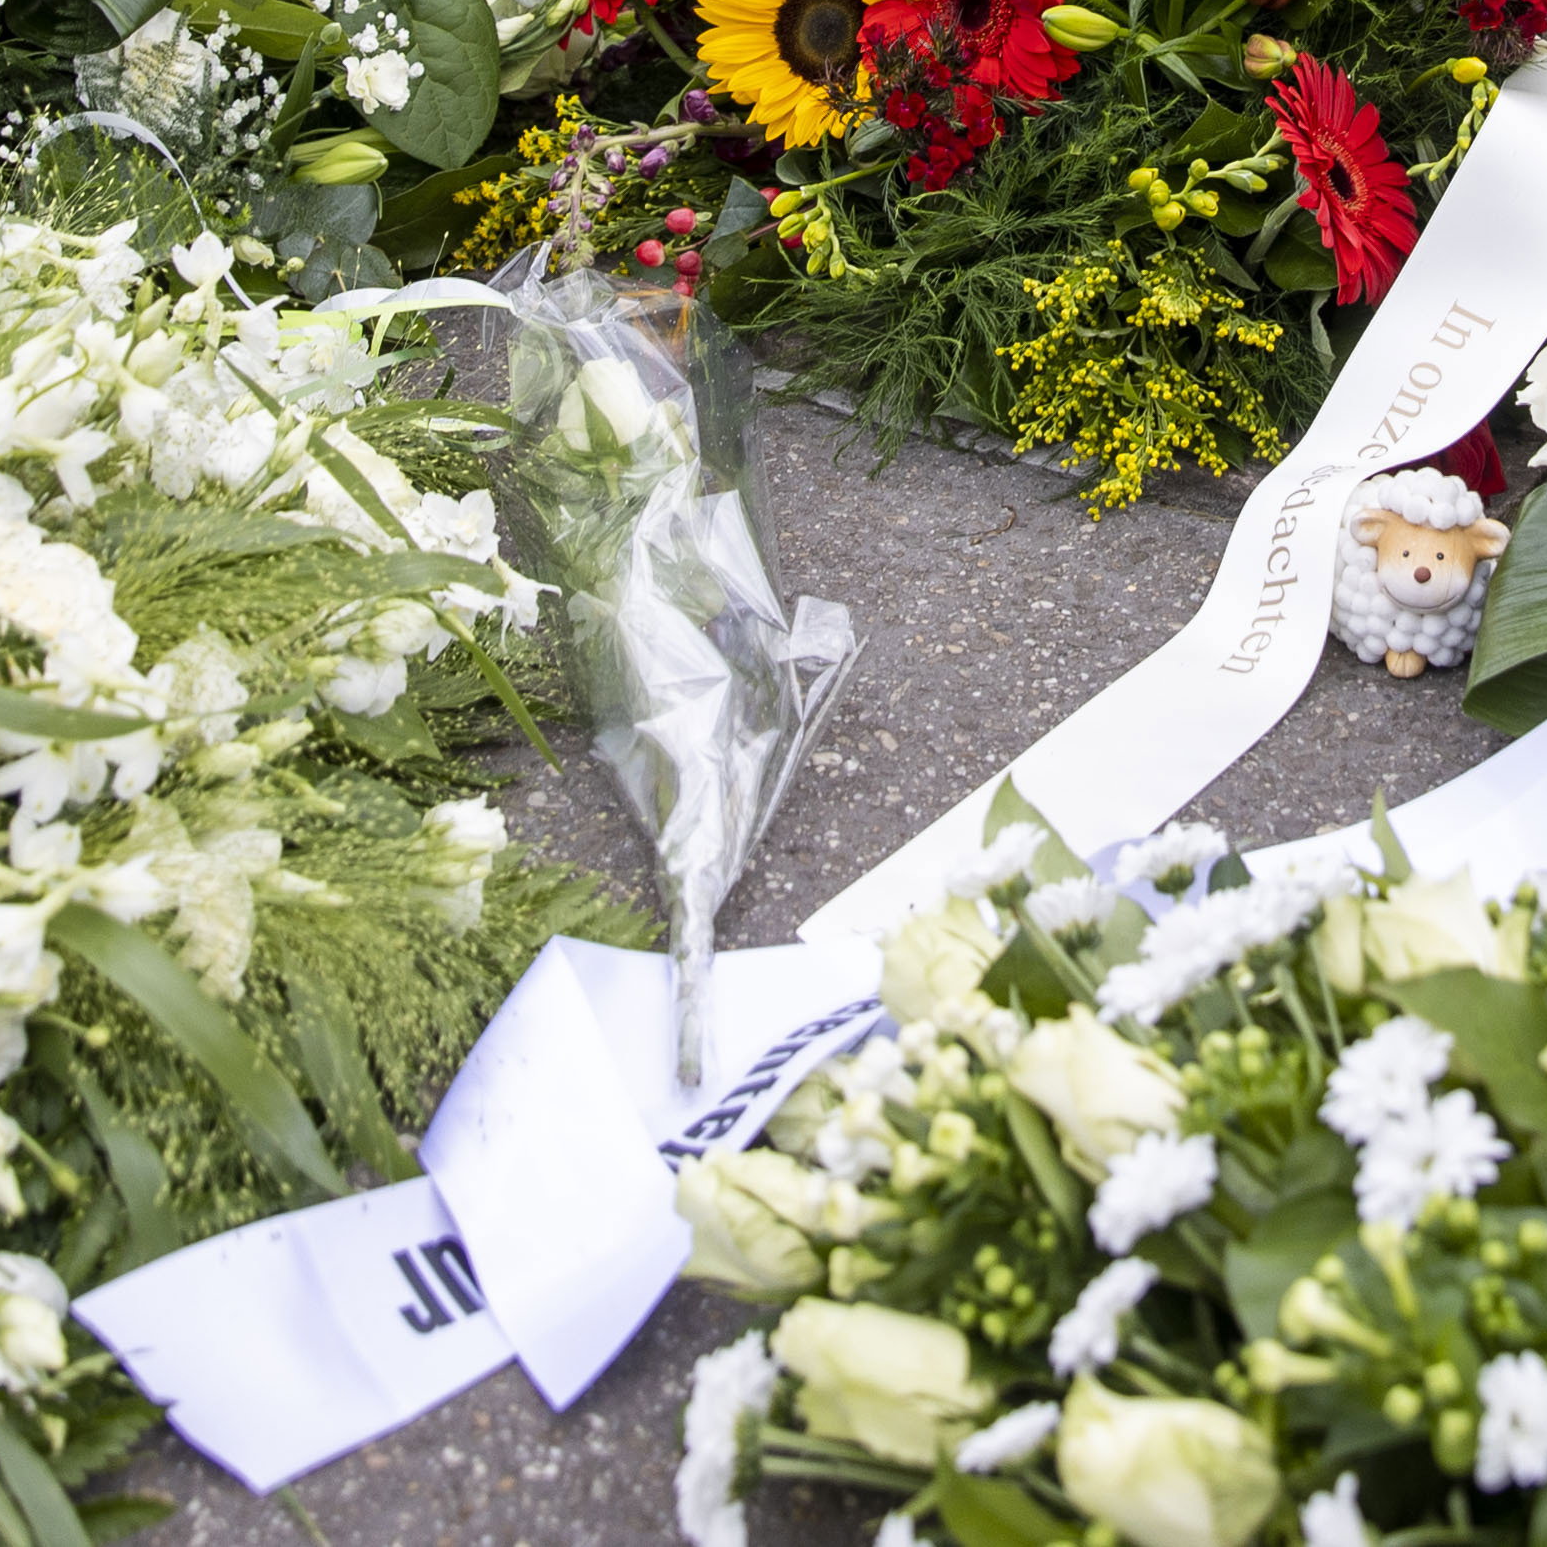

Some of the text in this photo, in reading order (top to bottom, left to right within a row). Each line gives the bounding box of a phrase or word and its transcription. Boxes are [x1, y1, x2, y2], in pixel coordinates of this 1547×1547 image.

[1218, 298, 1497, 678] In onze gedachten
